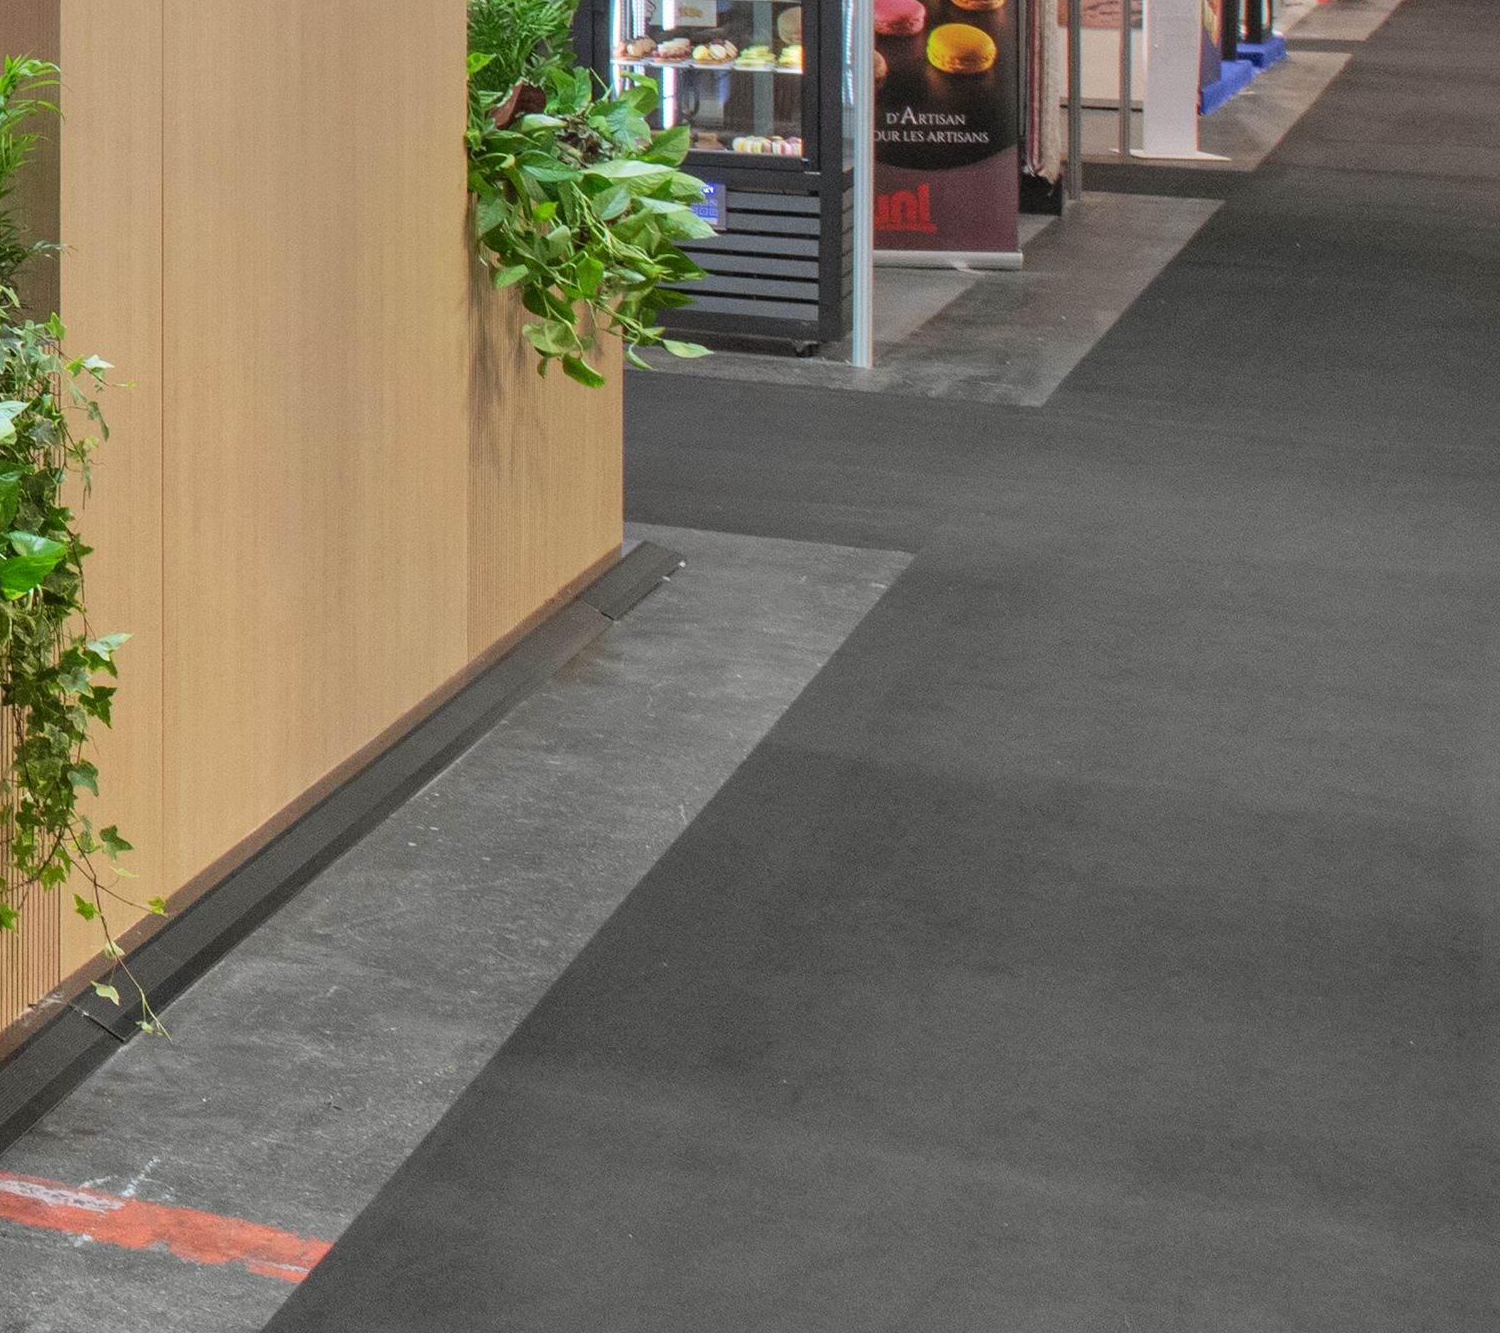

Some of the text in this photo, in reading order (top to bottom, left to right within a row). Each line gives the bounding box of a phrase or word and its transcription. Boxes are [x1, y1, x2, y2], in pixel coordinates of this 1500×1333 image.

[873, 130, 990, 144] OUR LES ARTISANS
